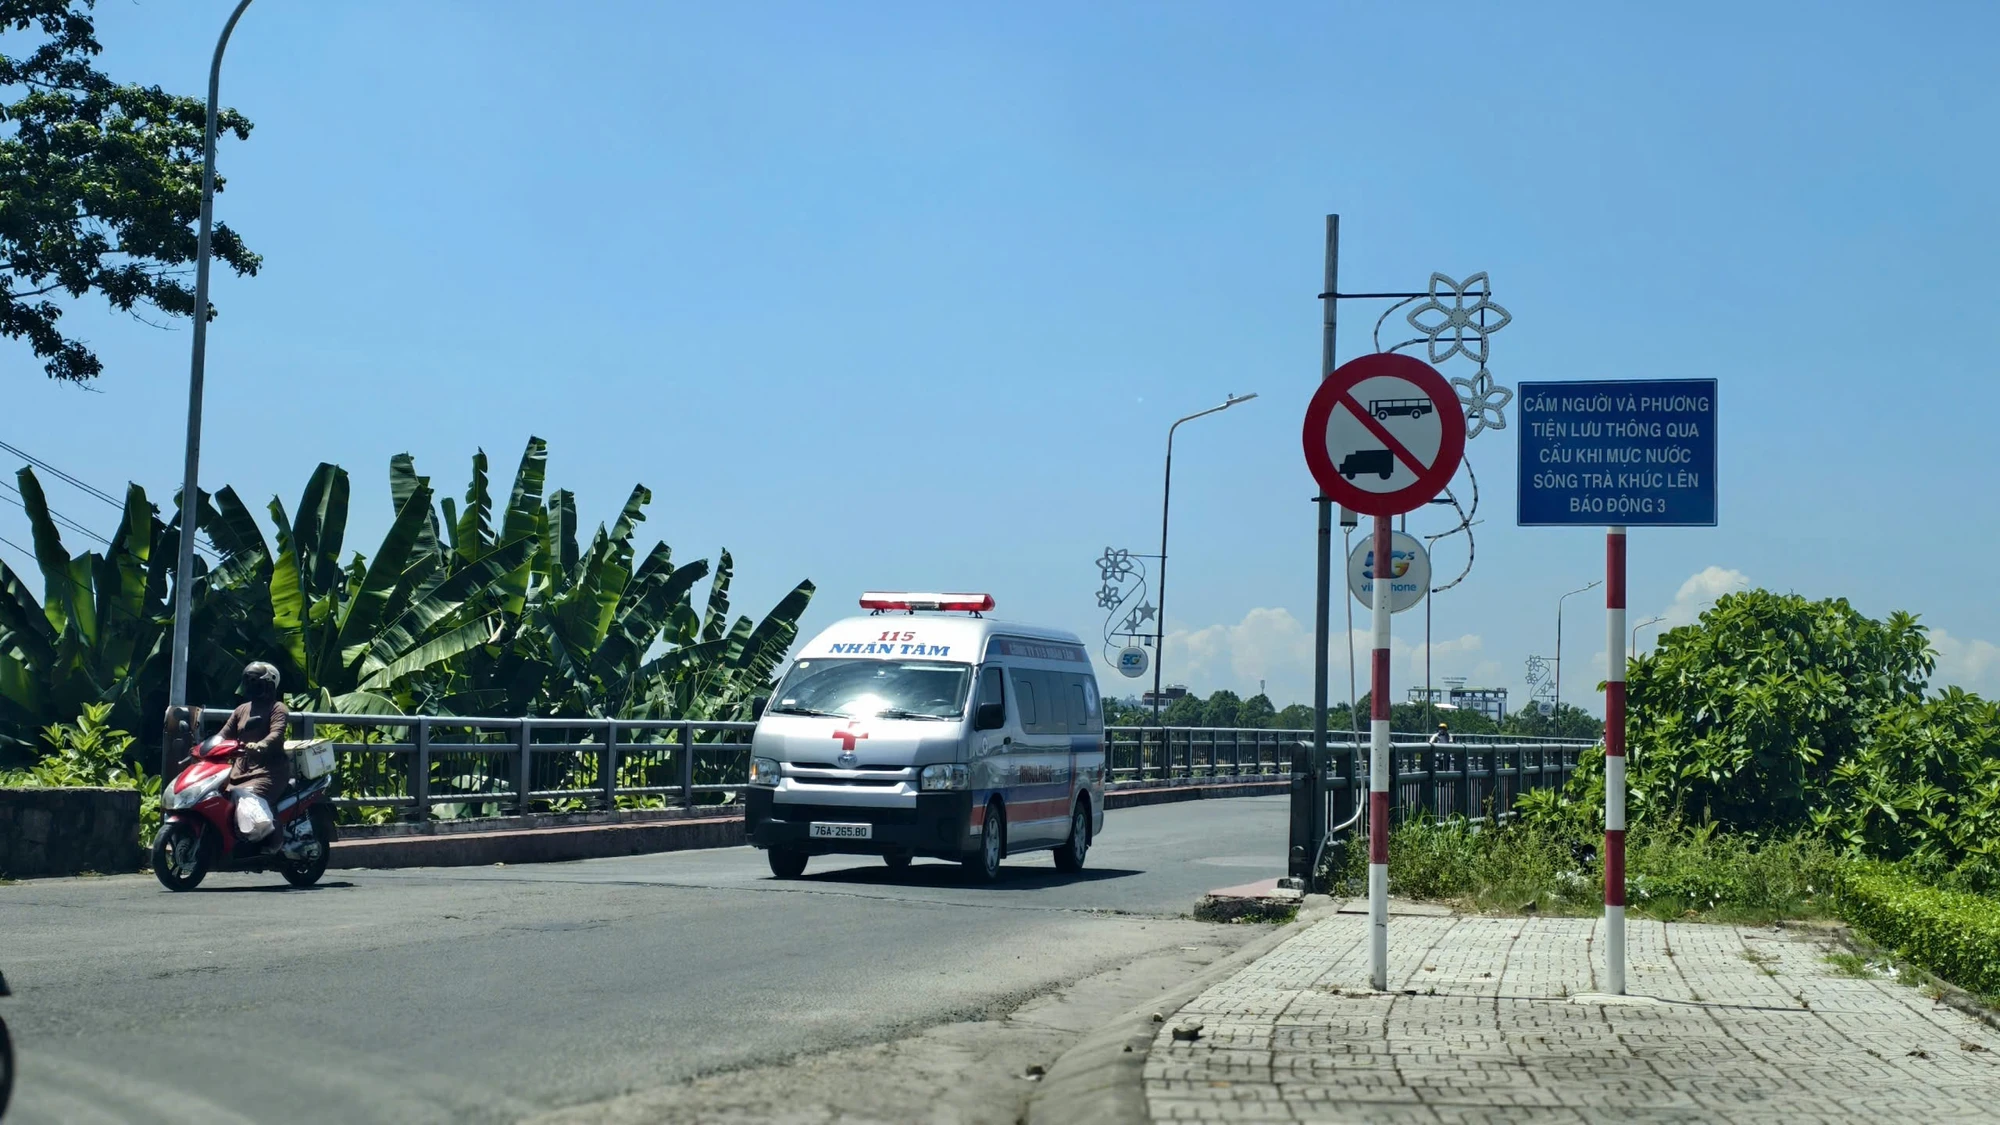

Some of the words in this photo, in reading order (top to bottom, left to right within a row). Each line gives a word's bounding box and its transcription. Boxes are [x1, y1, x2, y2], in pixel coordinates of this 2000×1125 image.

[1524, 392, 1558, 412] CẤM
[1562, 393, 1612, 412] NGƯỜI
[1616, 393, 1637, 412] VÀ
[1641, 395, 1709, 412] PHƯƠNG
[1531, 419, 1566, 440] TIỆN
[1571, 421, 1601, 437] LƯU
[1606, 419, 1661, 437] THÔNG
[1666, 422, 1699, 438] QUA
[1539, 443, 1572, 463] CẦU
[1576, 448, 1602, 463] KHI
[1606, 447, 1642, 467] MỰC
[1646, 444, 1691, 463] NƯỚC
[1533, 470, 1578, 489] SÔNG
[1582, 469, 1613, 488] TRÀ
[1618, 469, 1663, 488] KHÚC
[1667, 469, 1699, 488] LÊN
[1570, 493, 1603, 512] BÁO
[1607, 494, 1652, 516] ĐỘNG
[1657, 498, 1666, 512] 3
[1361, 582, 1417, 592] vihone
[878, 631, 916, 641] 115
[828, 641, 895, 654] NHÂN
[900, 643, 951, 656] TÂM
[815, 826, 867, 837] 76A-265.80
